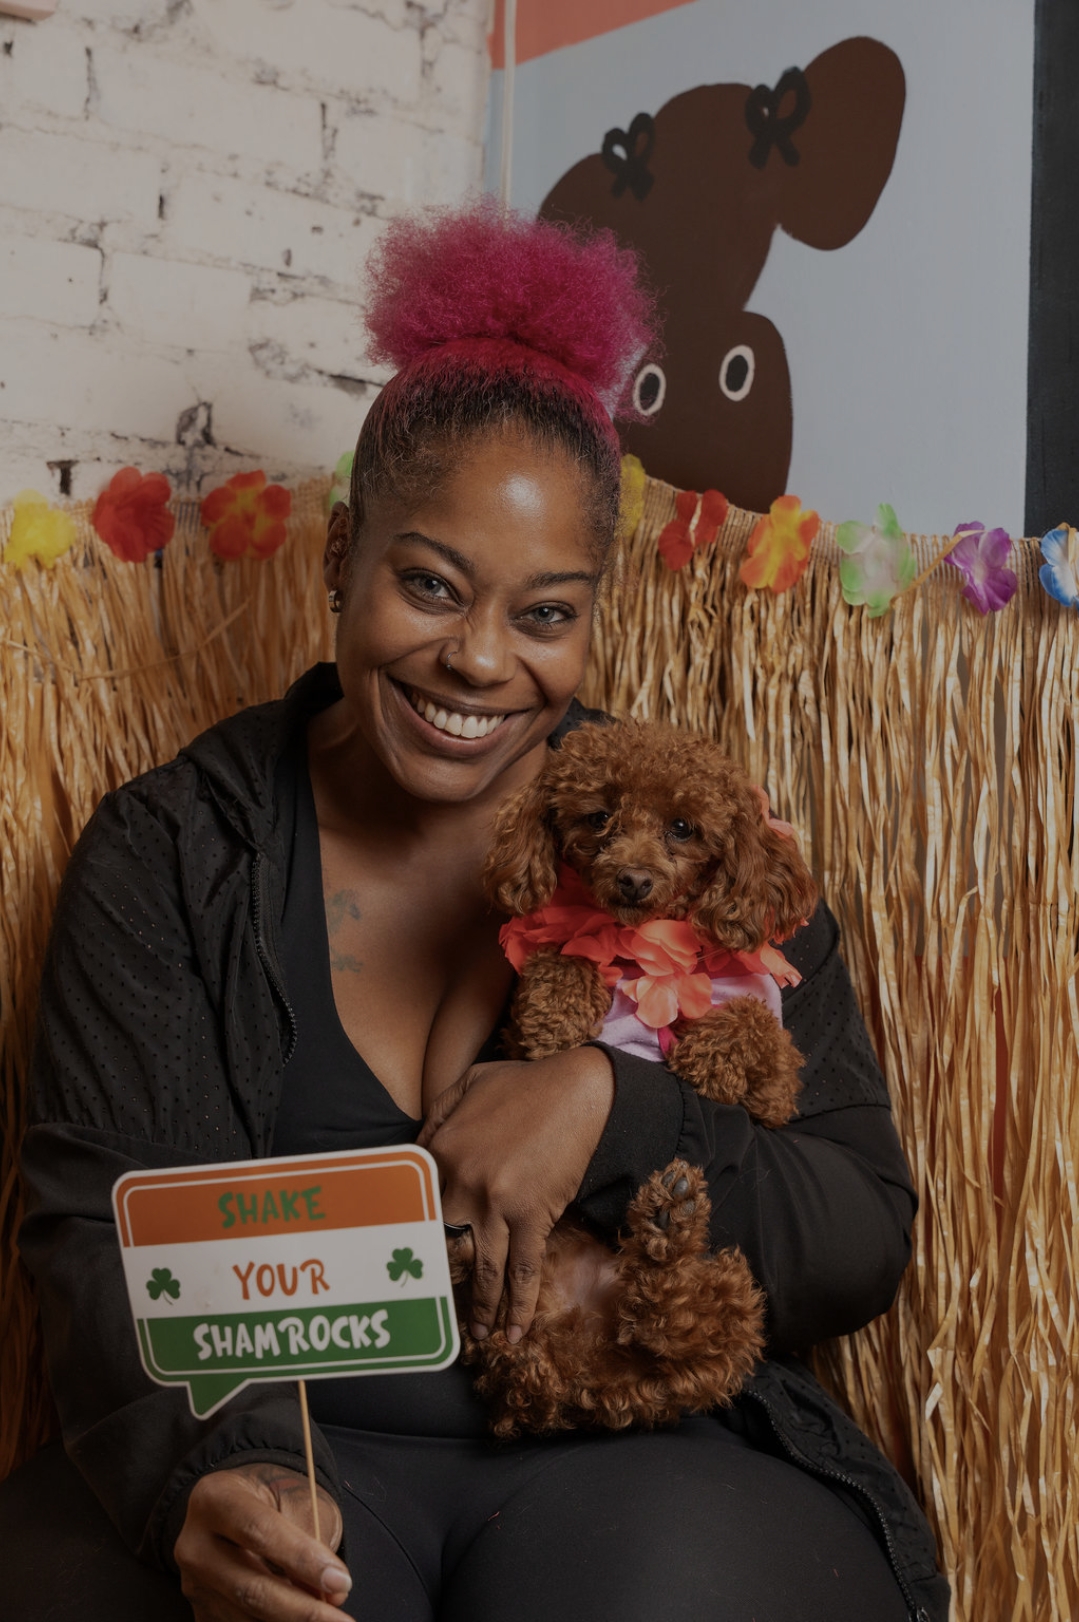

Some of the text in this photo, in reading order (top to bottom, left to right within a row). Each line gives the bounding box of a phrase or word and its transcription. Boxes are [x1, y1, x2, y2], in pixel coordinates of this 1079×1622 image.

[218, 1185, 326, 1228] SHAKE
[232, 1259, 330, 1300] YOUR
[193, 1309, 391, 1361] SHAMROCKS
